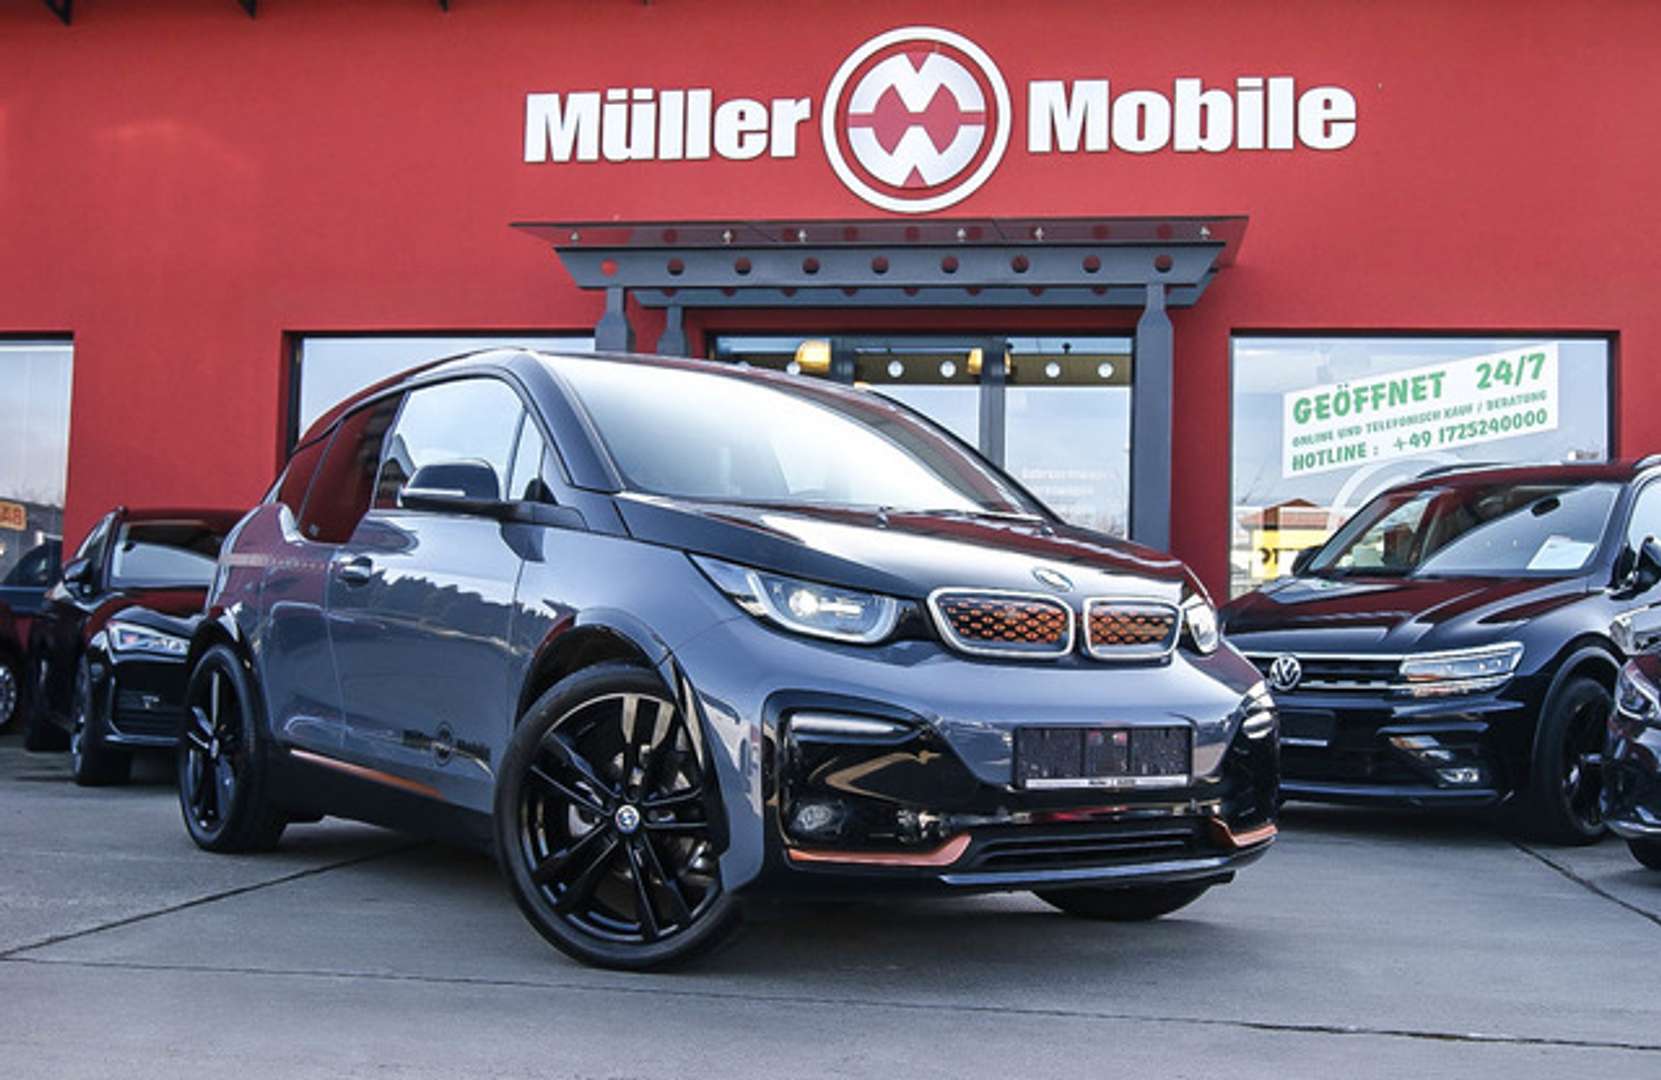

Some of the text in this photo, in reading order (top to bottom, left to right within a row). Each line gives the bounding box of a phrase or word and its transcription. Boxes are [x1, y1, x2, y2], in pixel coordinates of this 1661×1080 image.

[524, 76, 1357, 163] Müller Mobile
[1293, 352, 1546, 424] GEÖFFNET 24/7
[1292, 430, 1333, 447] ONLINE
[1337, 425, 1362, 439] UND
[1292, 442, 1367, 471] HOTLINE
[1394, 430, 1432, 451] +49
[1438, 408, 1548, 444] 1725240000
